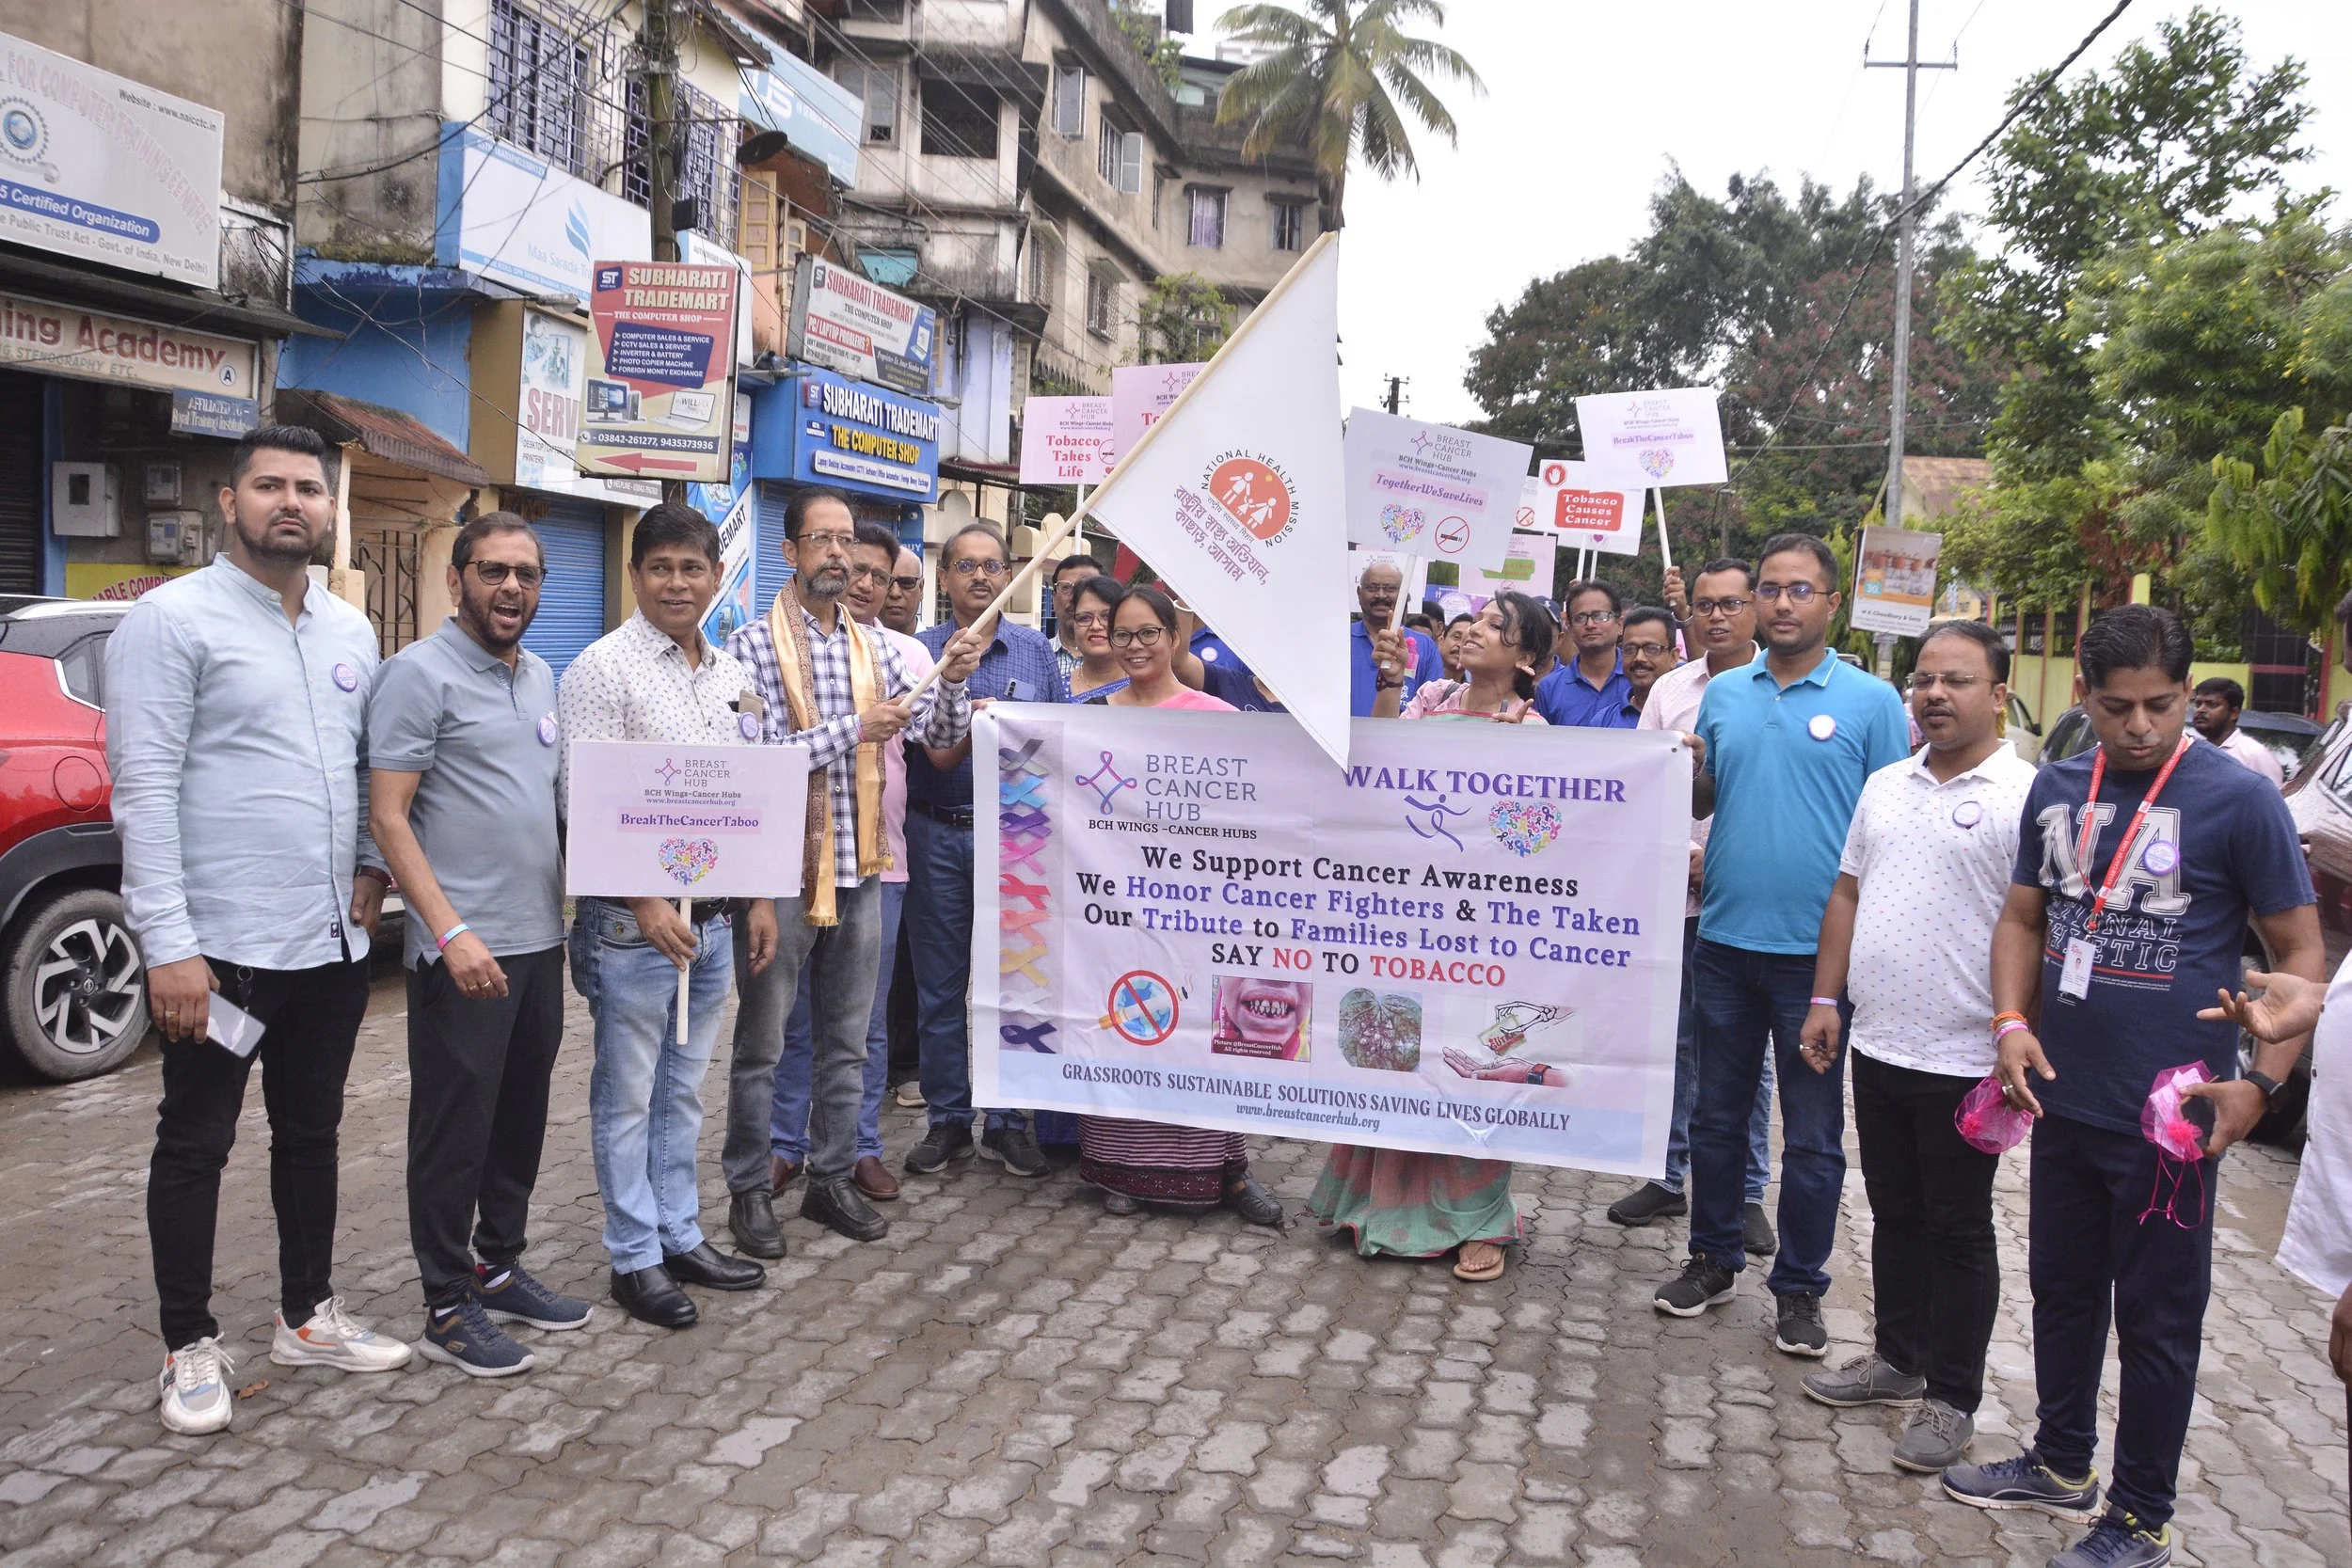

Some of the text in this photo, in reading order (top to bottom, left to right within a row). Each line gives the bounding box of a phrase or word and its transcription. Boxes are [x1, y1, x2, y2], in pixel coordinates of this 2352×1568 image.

[119, 88, 151, 109] Website
[8, 51, 215, 235] FOR COMPUTER TRAINING CENTRE
[11, 188, 151, 237] Certified Organization
[9, 215, 41, 233] Public
[45, 222, 71, 241] Trust
[73, 230, 90, 245] Act
[98, 238, 122, 253] Govt.
[124, 245, 134, 256] of
[136, 247, 161, 263] India,
[163, 253, 182, 268] New
[184, 260, 209, 277] Delhi)
[527, 243, 579, 276] Maa Sarada
[601, 271, 619, 284] ST
[628, 267, 728, 289] SUBHARATI
[624, 289, 730, 311] TRADEMART
[827, 270, 914, 326] SUBHARATI TRADEMART
[632, 311, 679, 323] COMPUTER
[679, 314, 703, 324] SHOP
[844, 303, 854, 314] THE
[854, 309, 881, 326] COMPUTER
[881, 316, 893, 330] SHOP
[621, 332, 656, 341] COMPUTER
[683, 336, 710, 344] SERVICE
[818, 319, 839, 343] LAPTOP
[75, 314, 227, 372] Academy
[16, 346, 104, 372] STENOGRAPHY
[110, 363, 138, 377] ETC.
[620, 349, 650, 357] INVERTER
[657, 351, 684, 359] BATTERY
[641, 358, 665, 367] COPIER
[665, 360, 694, 369] MACHINE
[223, 369, 232, 382] A
[618, 366, 646, 374] FOREIGN
[669, 368, 704, 377] EXCHANGE
[188, 397, 230, 415] AFFILIATED
[823, 382, 940, 442] SUBHARATI TRADEMART
[190, 410, 218, 433] Training
[598, 435, 714, 450] 03842-261277, 9435373936
[832, 424, 850, 449] THE
[851, 429, 898, 461] COMPUTER
[898, 442, 920, 465] SHOP
[1046, 436, 1102, 447] Tobacco
[1437, 434, 1471, 449] BREAST
[1613, 432, 1693, 445] BreakTheCancerTaboo
[522, 452, 545, 464] PRINTERS
[1053, 450, 1091, 462] Takes
[1432, 451, 1453, 462] HUB
[1435, 443, 1472, 458] CANCER
[1057, 466, 1084, 477] Life
[1398, 454, 1477, 478] BCH Wings-Cancer Hubs
[1398, 463, 1471, 484] www.breastcancerhub.org
[1201, 449, 1299, 547] NATIONAL HEALTH MISSION
[1375, 473, 1484, 507] TogetherWeSaveLives
[1564, 494, 1618, 505] Tobacco
[1566, 504, 1613, 515] Causes
[1565, 515, 1612, 526] Cancer
[684, 768, 730, 779] CANCER
[686, 759, 727, 768] BREAST
[1146, 753, 1248, 777] BREAST
[684, 778, 707, 787] HUB
[1343, 764, 1627, 802] WALK TOGETHER
[2154, 768, 2169, 788] CANCER
[664, 789, 720, 799] Wings-Cancer
[1145, 777, 1257, 801] CANCER
[646, 798, 736, 806] www.breastcancerhub.org
[1145, 800, 1201, 821] HUB
[621, 814, 759, 828] BreakTheCancerTaboo
[1088, 819, 1114, 831] BCH
[1117, 821, 1158, 833] WINGS
[1222, 828, 1257, 840] HUBS
[2106, 814, 2143, 886] ASSAM CANCER CARE FOUNDATION
[1140, 846, 1579, 896] We Support Cancer Awareness
[1076, 872, 1640, 935] We Honor Cancer Fighters & The Taken
[1084, 903, 1631, 967] Our Tribute to Families Lost to Cancer
[1211, 942, 1505, 988] SAY NO TO TOBACCO
[1061, 1062, 1570, 1131] GRASSROOTS SUSTAINABLE SOLUTIONS SAVING LIVES GLOBALLY
[1235, 1101, 1380, 1132] www.breastcancerhub.org
